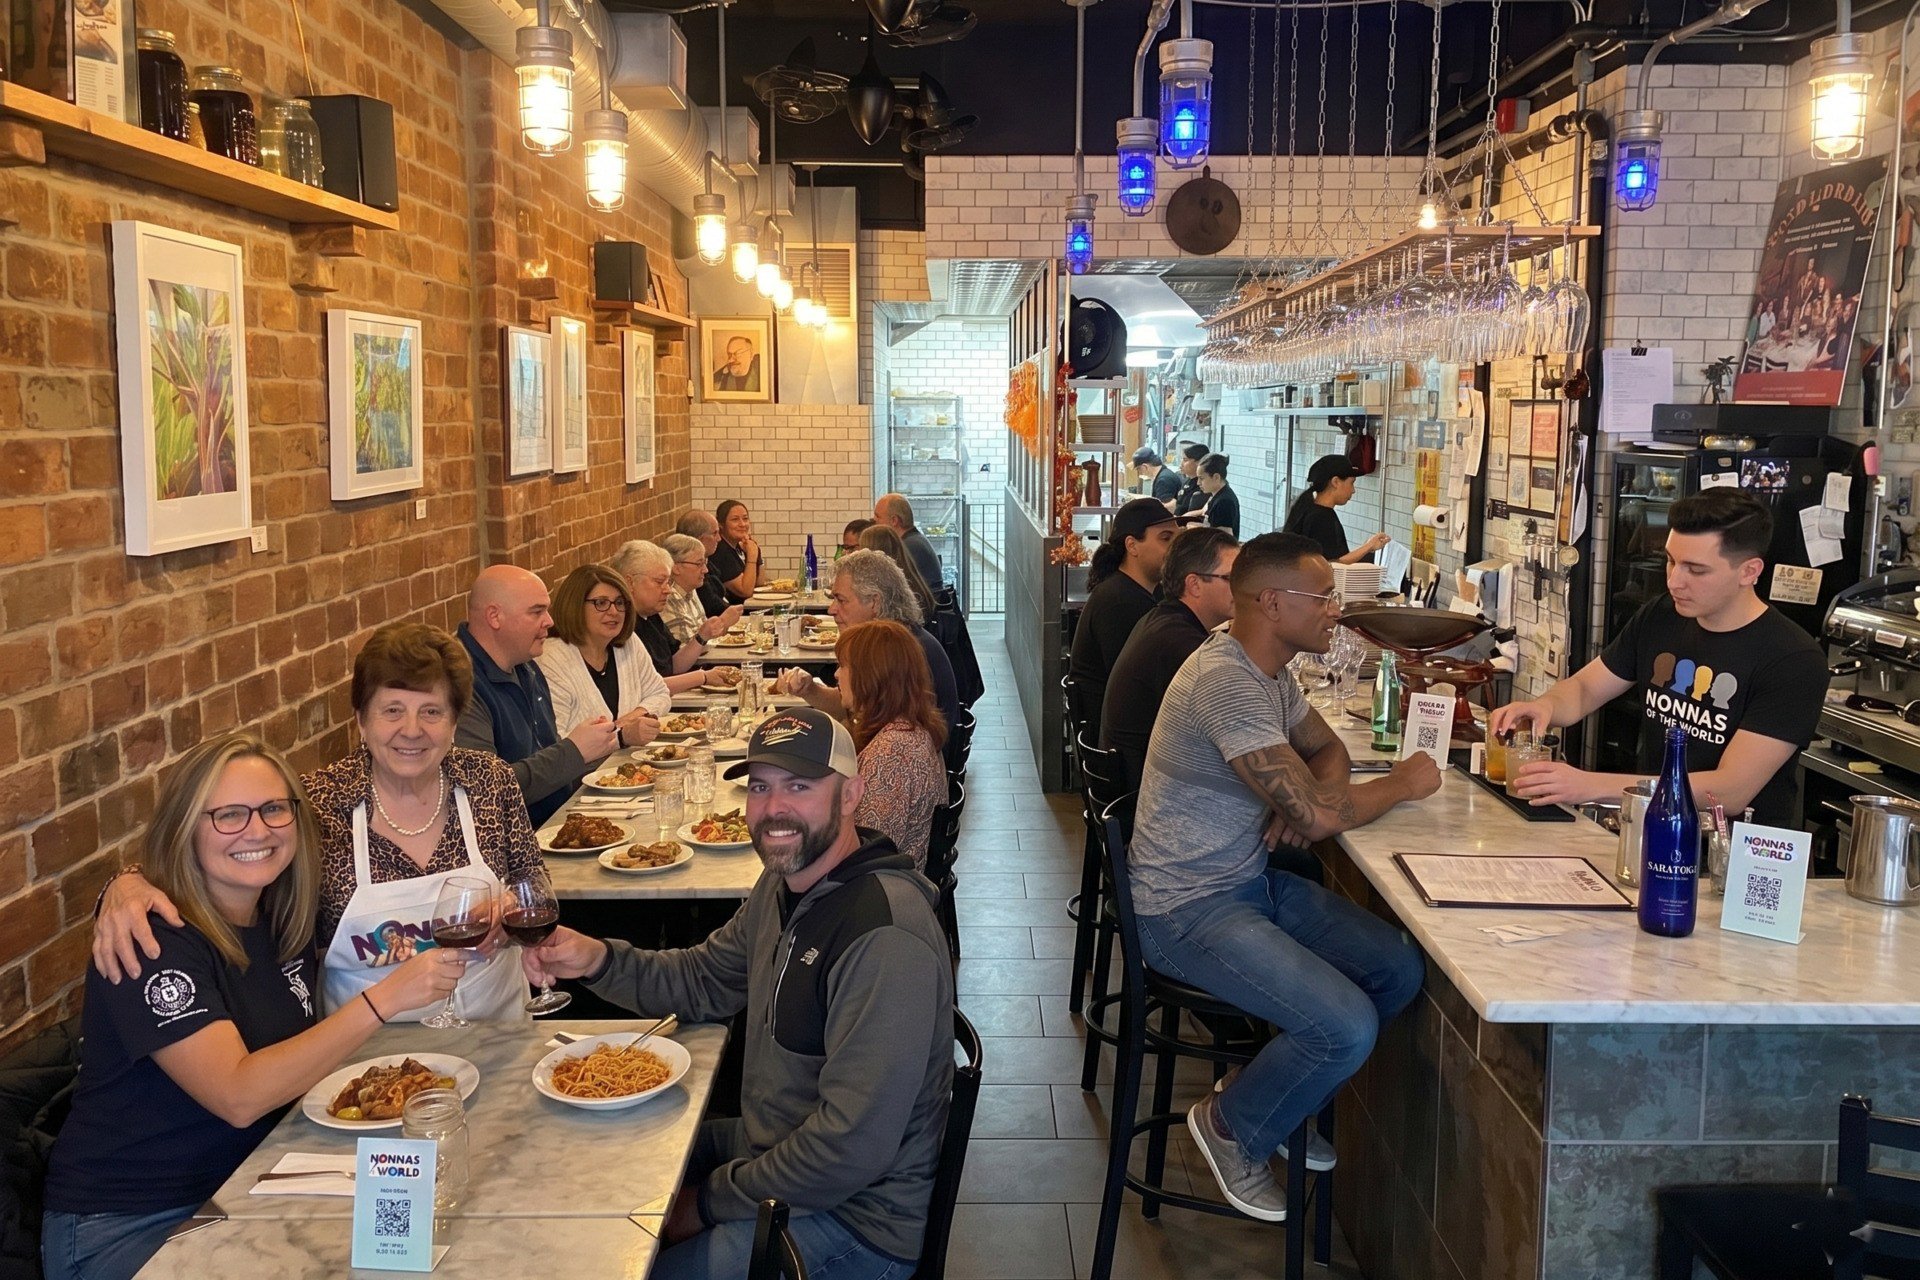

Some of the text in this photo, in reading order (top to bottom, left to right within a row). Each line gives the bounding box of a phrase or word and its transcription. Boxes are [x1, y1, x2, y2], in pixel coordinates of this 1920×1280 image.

[1645, 688, 1728, 732] NONNAS
[1646, 708, 1726, 745] OF THE WORLD
[1744, 835, 1794, 852] NONNAS
[370, 1153, 420, 1165] NONNAS
[377, 1166, 419, 1178] WORLD
